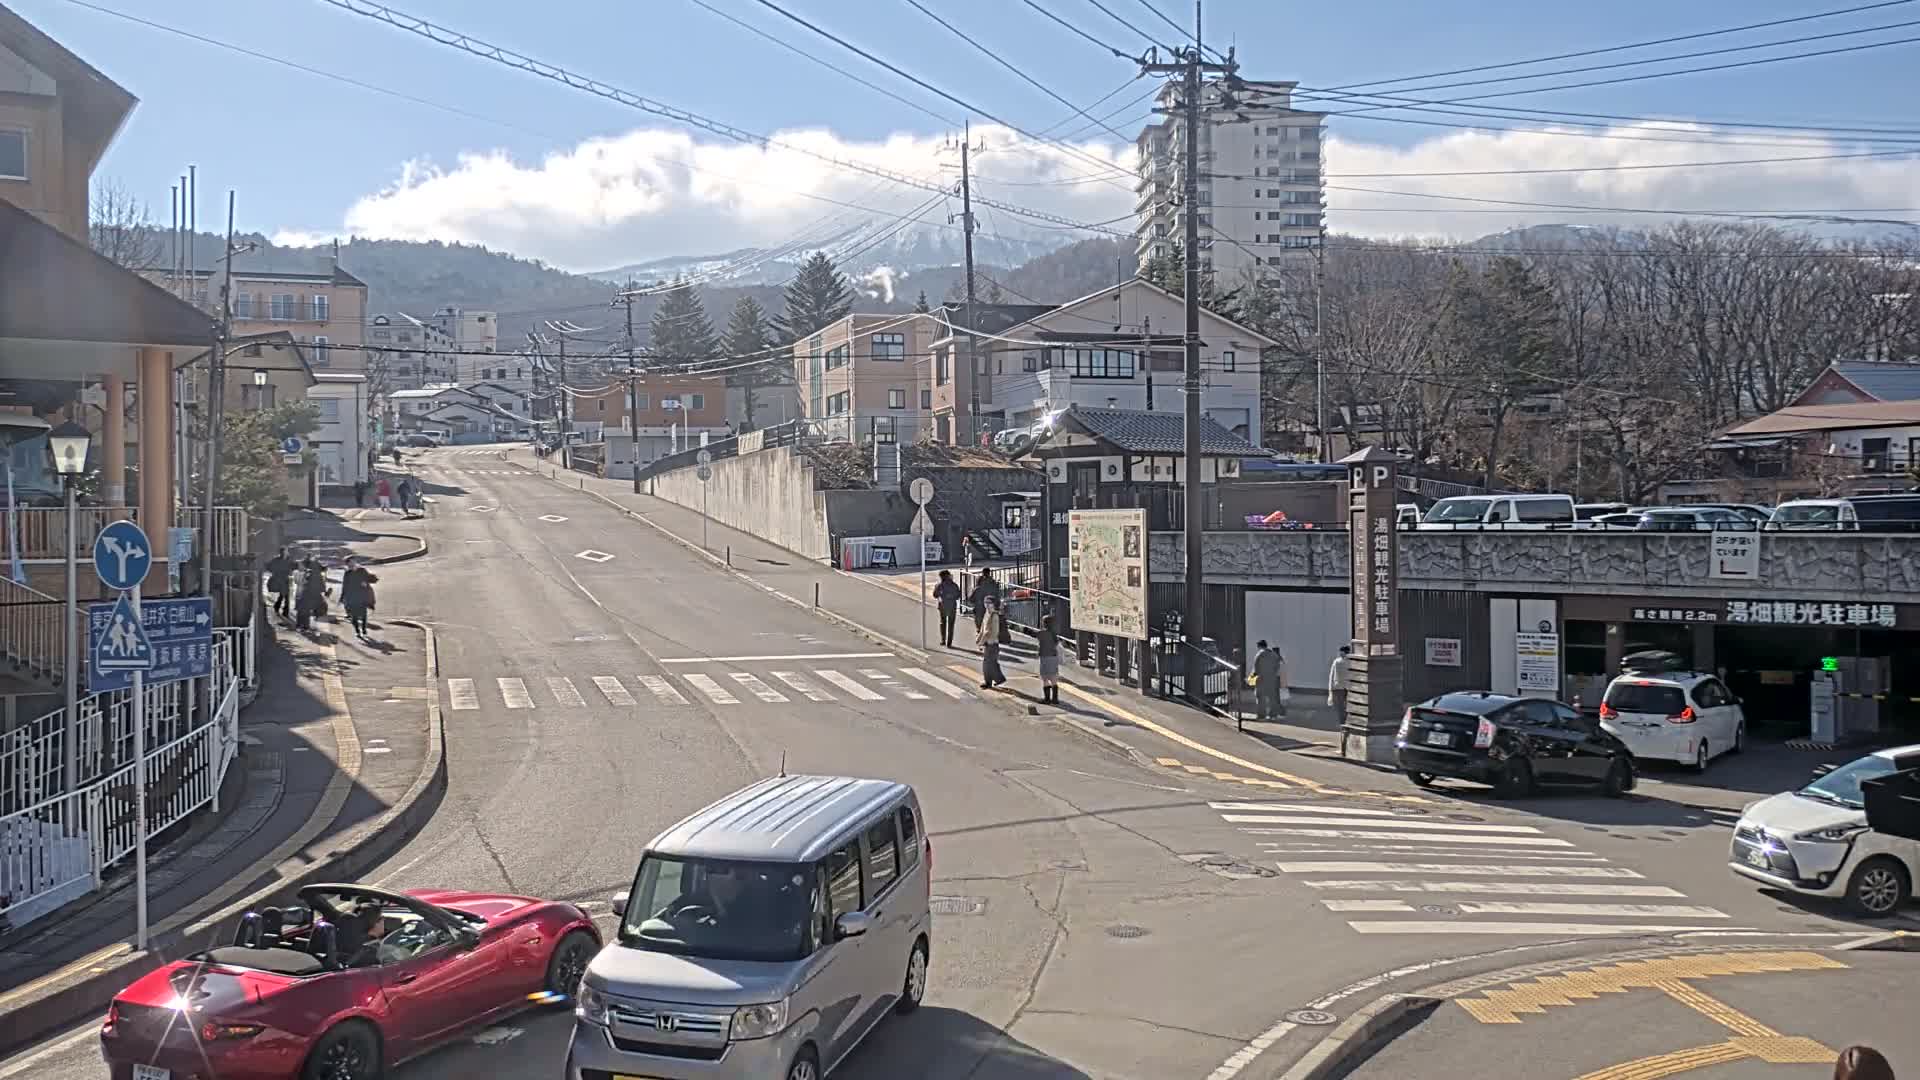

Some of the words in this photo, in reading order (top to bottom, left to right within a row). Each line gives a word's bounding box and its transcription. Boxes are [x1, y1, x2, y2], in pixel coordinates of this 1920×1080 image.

[1354, 467, 1363, 488] P
[1373, 467, 1388, 488] P
[1374, 517, 1390, 634] 湯畑観光駐車場
[1727, 602, 1897, 627] 湯畑観光駐車場
